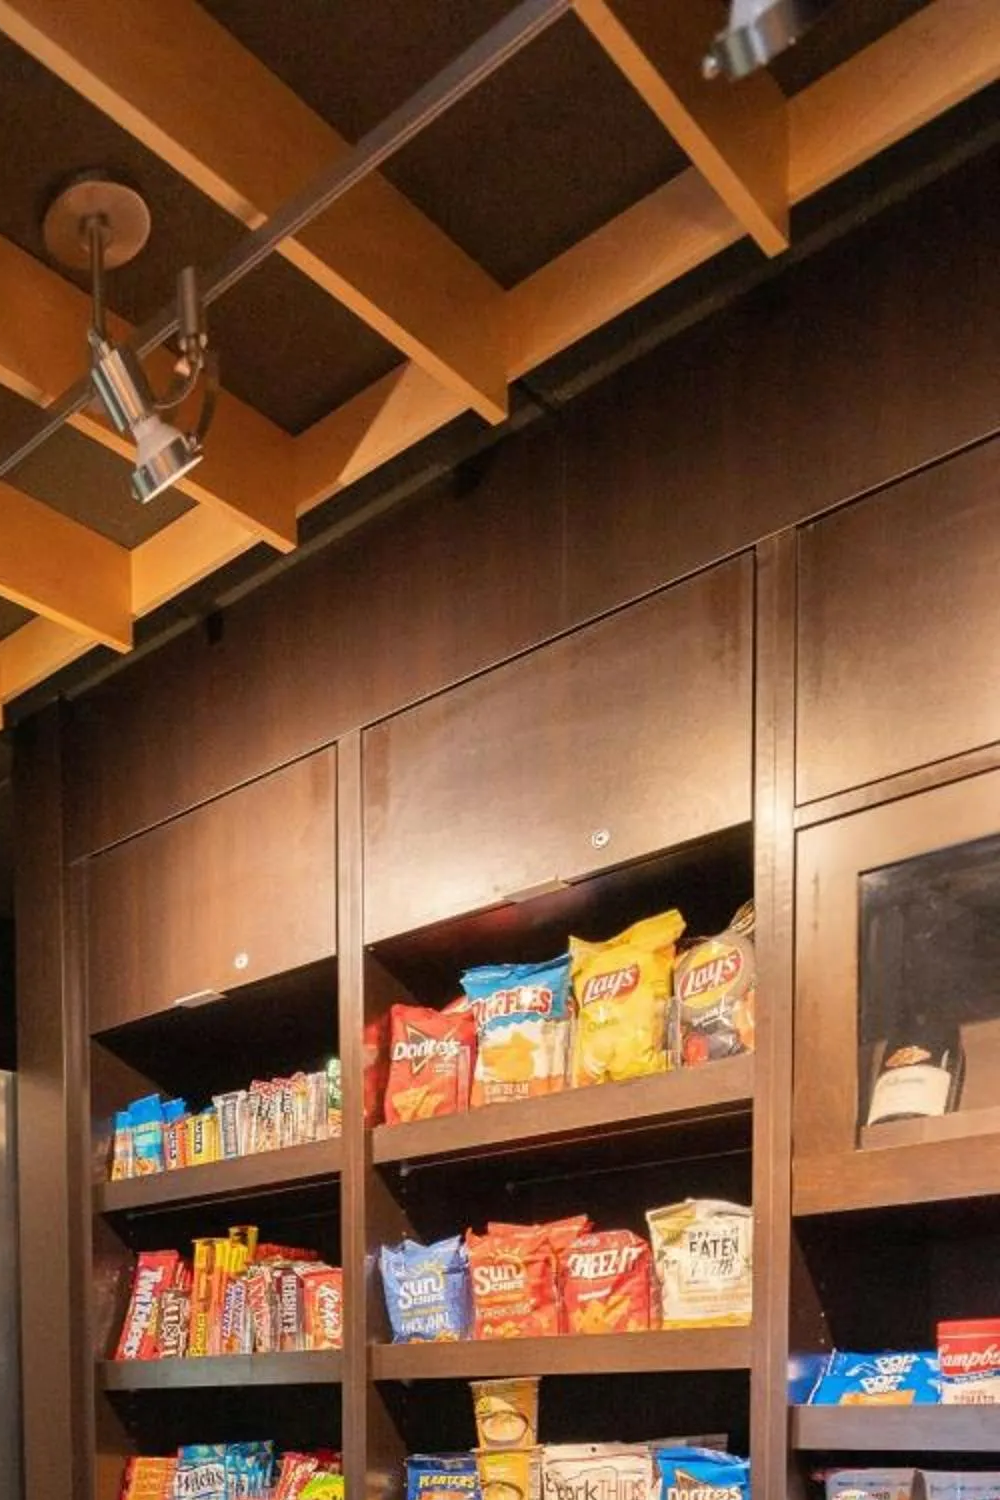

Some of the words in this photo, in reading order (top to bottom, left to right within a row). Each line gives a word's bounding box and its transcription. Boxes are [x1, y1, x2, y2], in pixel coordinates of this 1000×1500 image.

[393, 1037, 459, 1061] Doritos
[689, 1237, 740, 1259] EATEN
[400, 1276, 442, 1309] Sun
[473, 1266, 523, 1297] Sun
